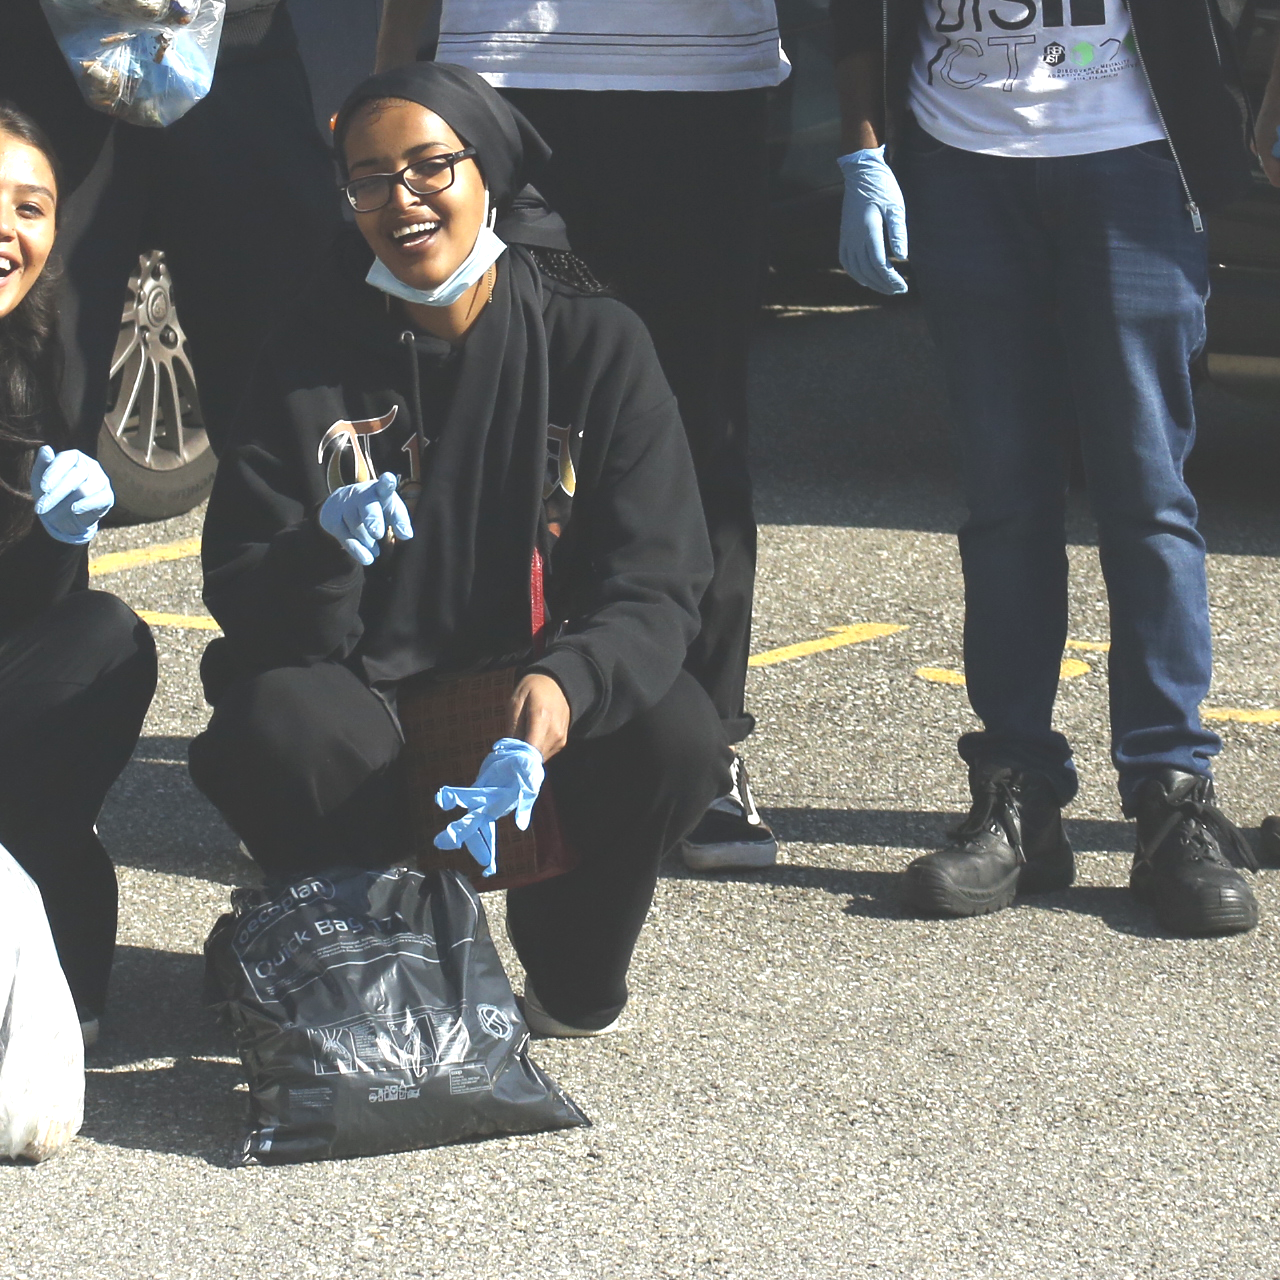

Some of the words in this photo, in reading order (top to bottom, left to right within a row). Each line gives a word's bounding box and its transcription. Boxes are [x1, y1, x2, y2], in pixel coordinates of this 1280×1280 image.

[238, 880, 324, 944] oecoplan
[255, 929, 312, 979] Quick
[314, 917, 364, 936] Bag
